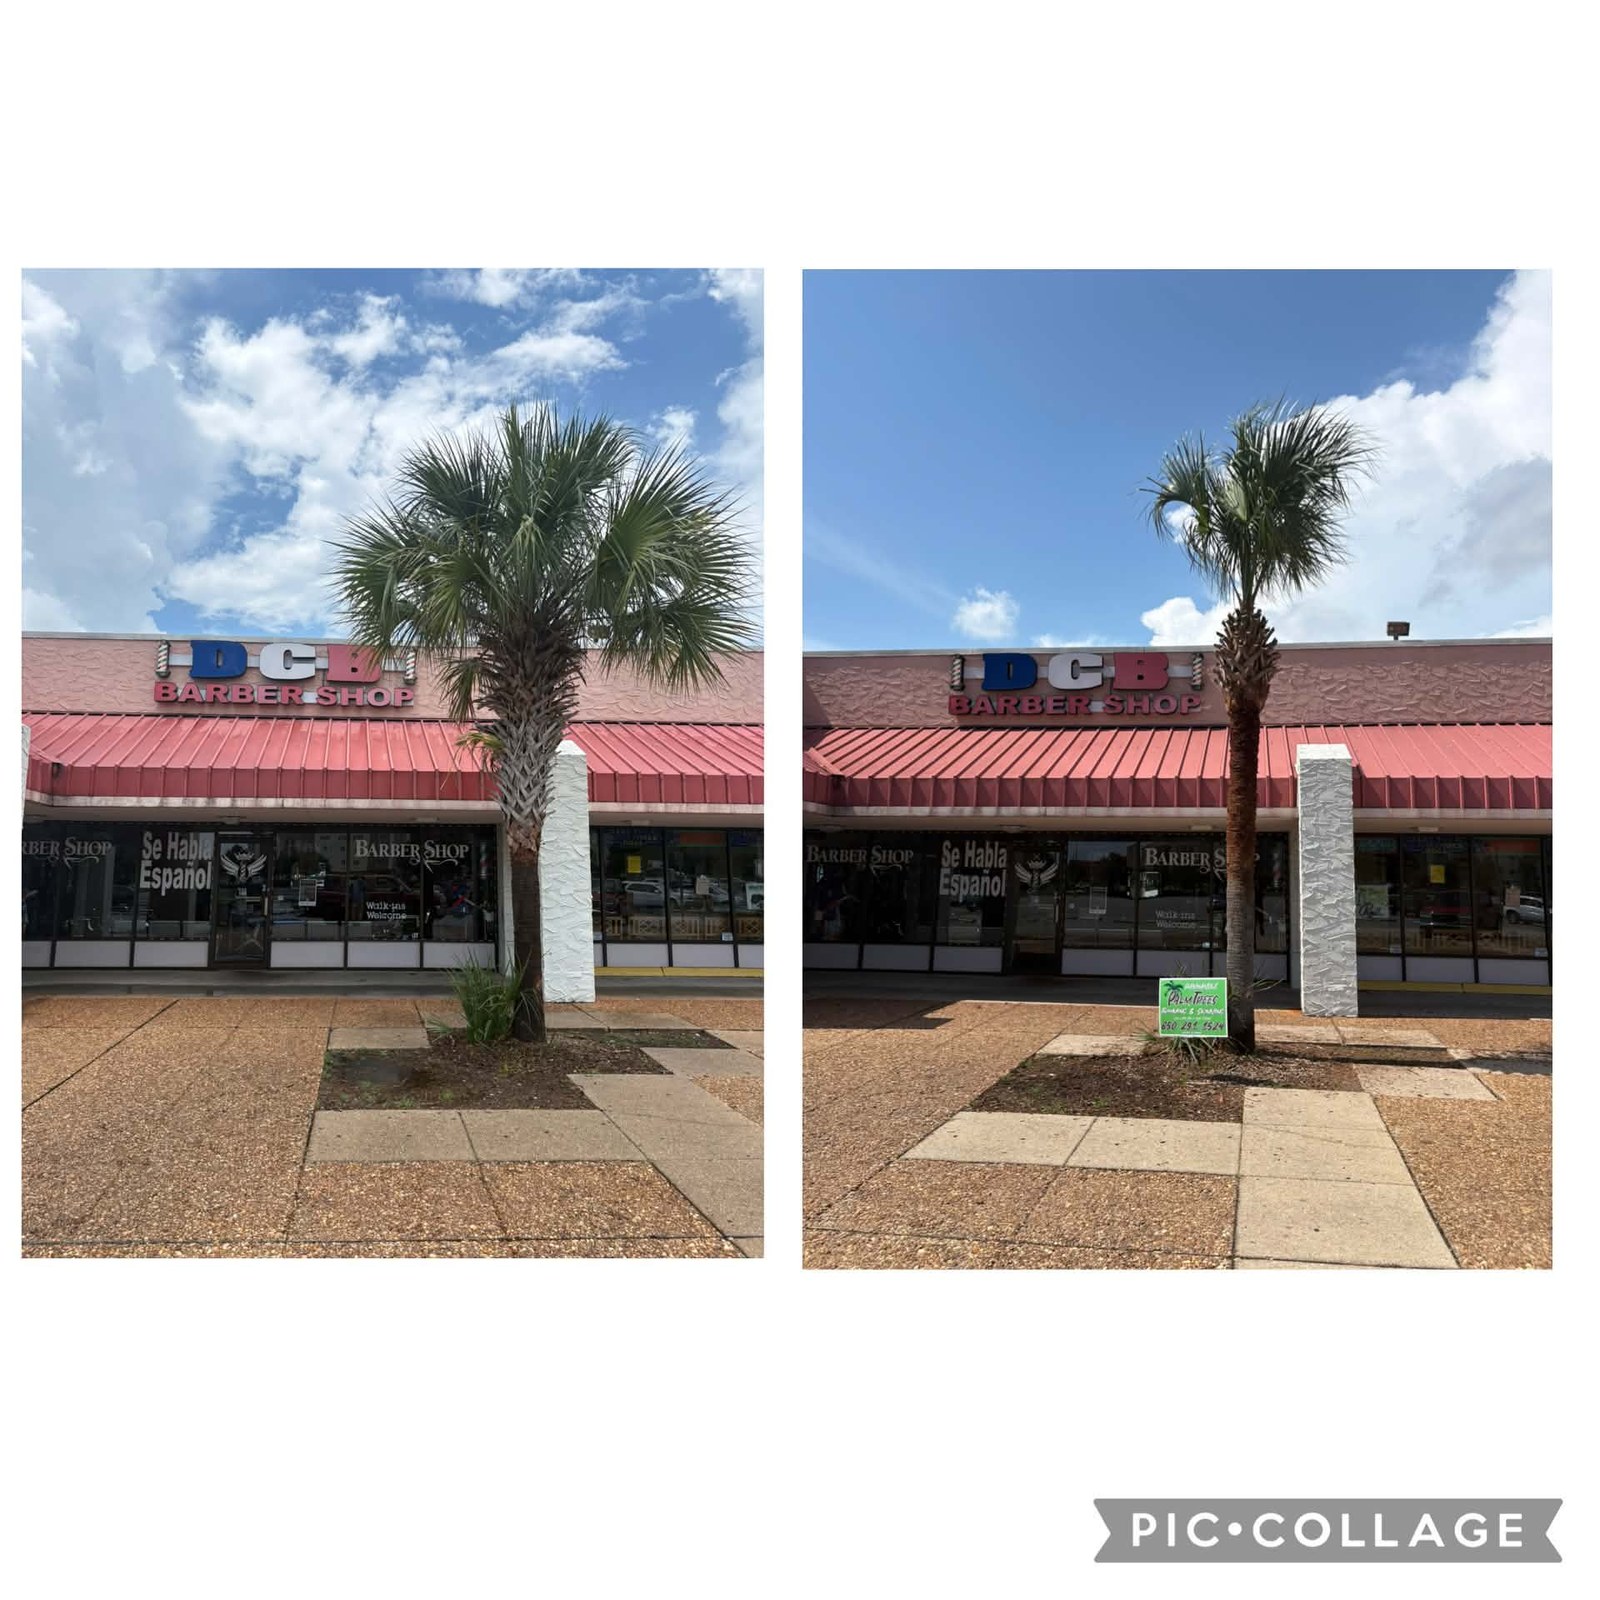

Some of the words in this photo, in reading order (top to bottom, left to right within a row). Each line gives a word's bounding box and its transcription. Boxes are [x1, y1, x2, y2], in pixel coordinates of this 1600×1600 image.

[190, 640, 381, 683] DCB
[981, 653, 1169, 690] DCB
[154, 681, 303, 705] BARBER
[316, 686, 414, 707] SHOP
[949, 694, 1093, 715] BARBER
[1103, 694, 1201, 715] SHOP
[64, 836, 113, 858] SHOP
[142, 831, 161, 860] Se
[166, 831, 212, 861] Habla
[355, 839, 420, 861] BARBER
[423, 840, 469, 860] SHOP
[806, 845, 867, 864] BARBER
[871, 845, 914, 864] SHOP
[941, 840, 960, 867] Se
[964, 840, 1007, 868] Habla
[1144, 847, 1211, 869] BARBER
[139, 861, 212, 896] Español
[939, 868, 1007, 903] Español
[366, 911, 407, 920] Welcome
